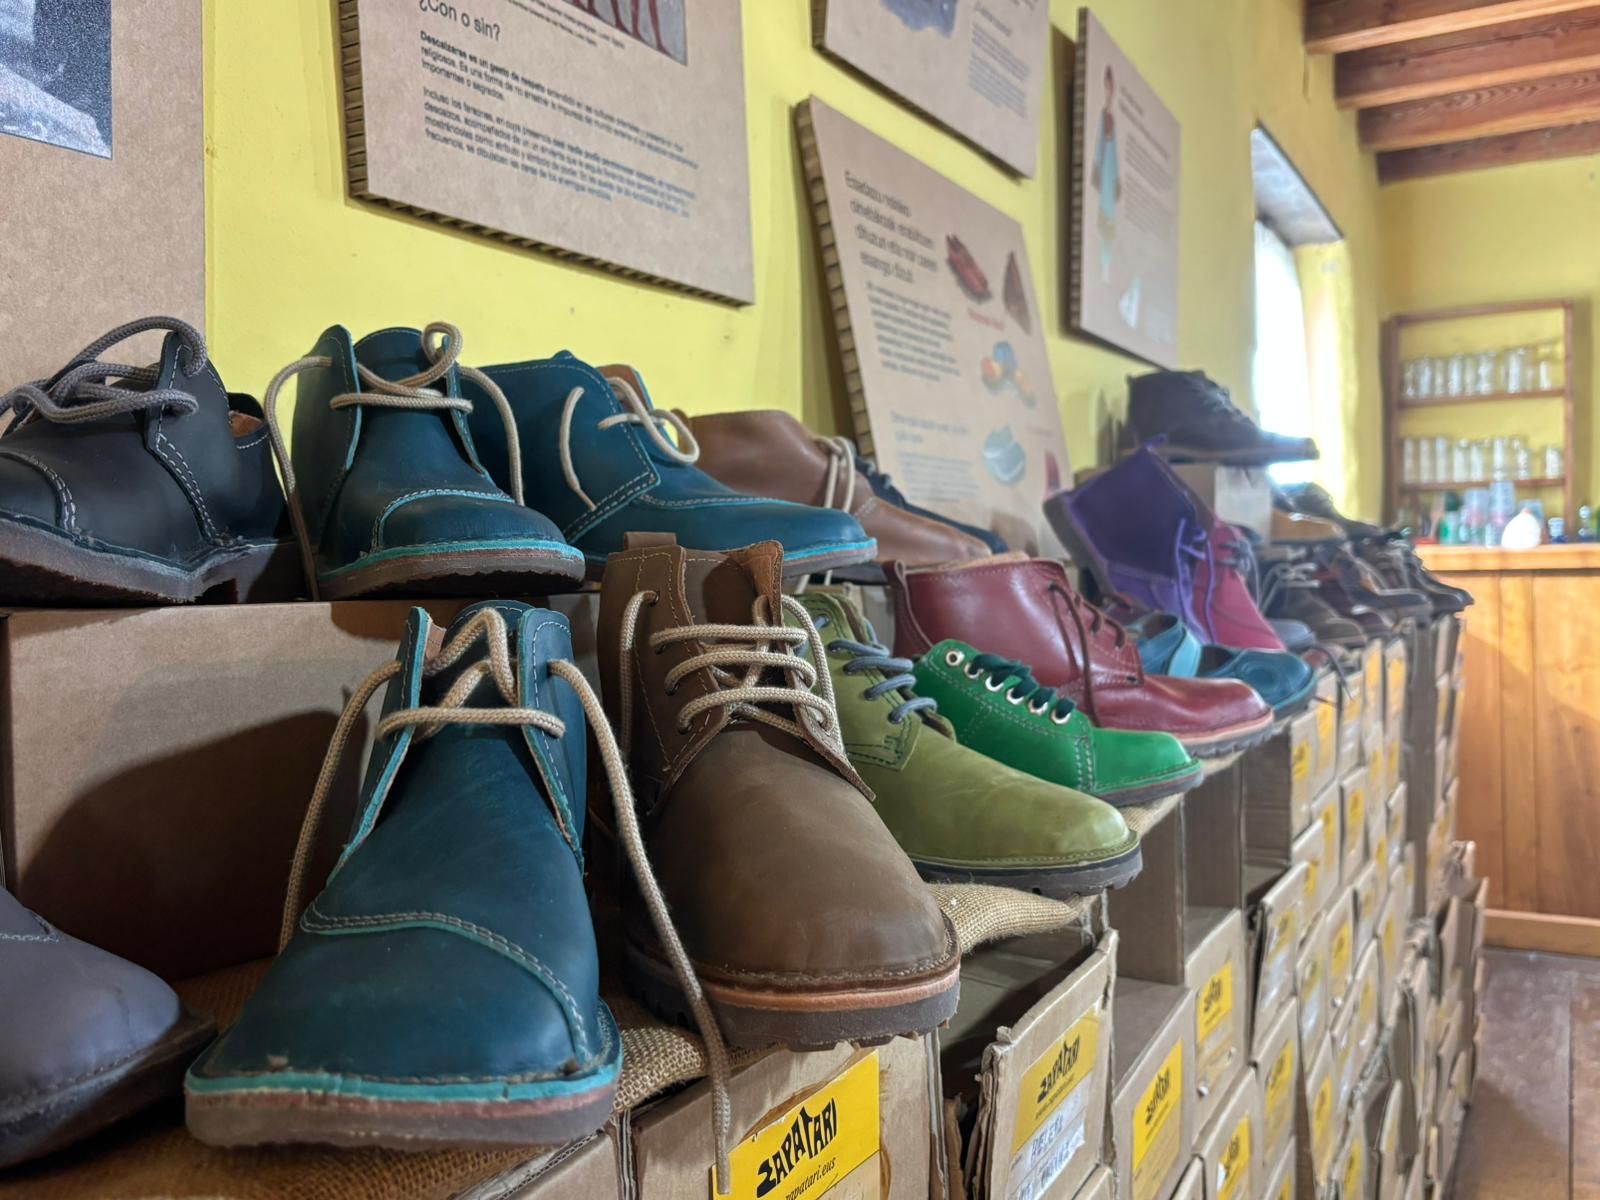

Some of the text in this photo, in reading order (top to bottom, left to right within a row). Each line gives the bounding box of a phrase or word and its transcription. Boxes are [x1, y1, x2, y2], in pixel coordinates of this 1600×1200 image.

[461, 12, 471, 29] o
[474, 17, 500, 42] sin?
[756, 1097, 838, 1198] ZAPATARI
